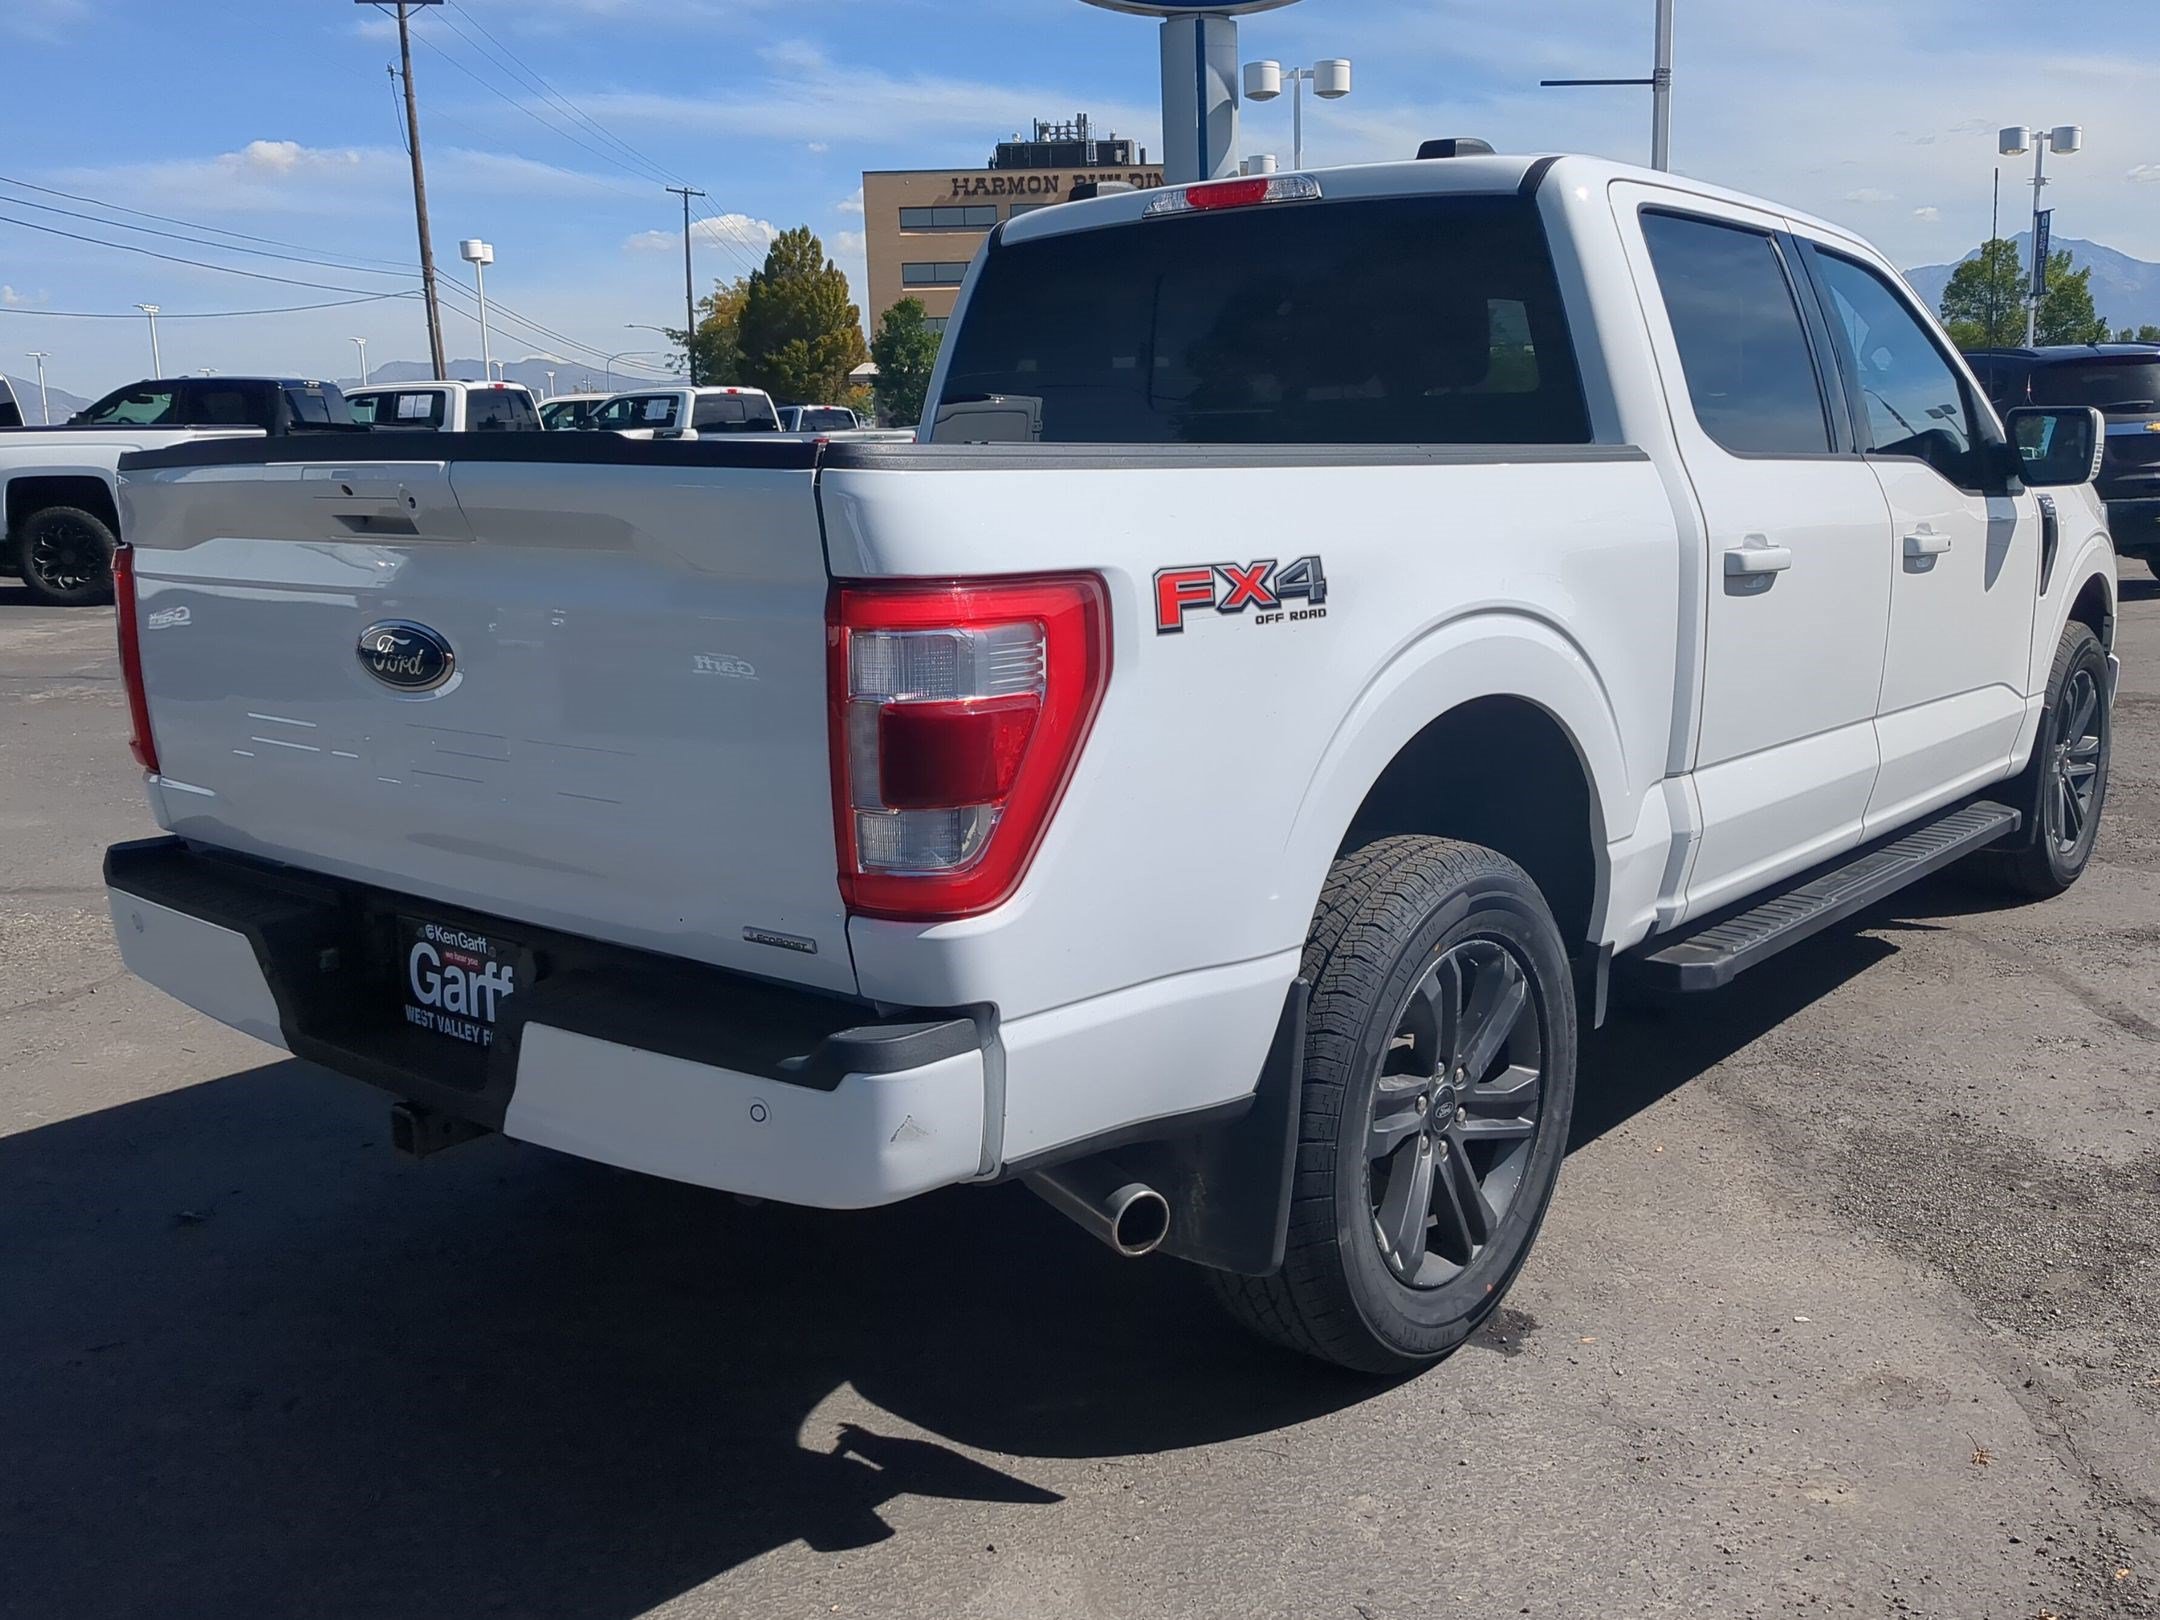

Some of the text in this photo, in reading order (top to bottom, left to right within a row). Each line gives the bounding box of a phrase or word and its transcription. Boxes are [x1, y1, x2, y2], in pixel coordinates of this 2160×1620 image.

[951, 174, 1060, 196] HARMON
[1153, 555, 1328, 636] FX4
[1255, 608, 1327, 625] OFF ROAD
[373, 634, 425, 675] Ford
[425, 923, 488, 954] @KenGarff
[409, 941, 514, 1023] Garff
[405, 1003, 435, 1030] WEST
[437, 1014, 481, 1044] VALLEY
